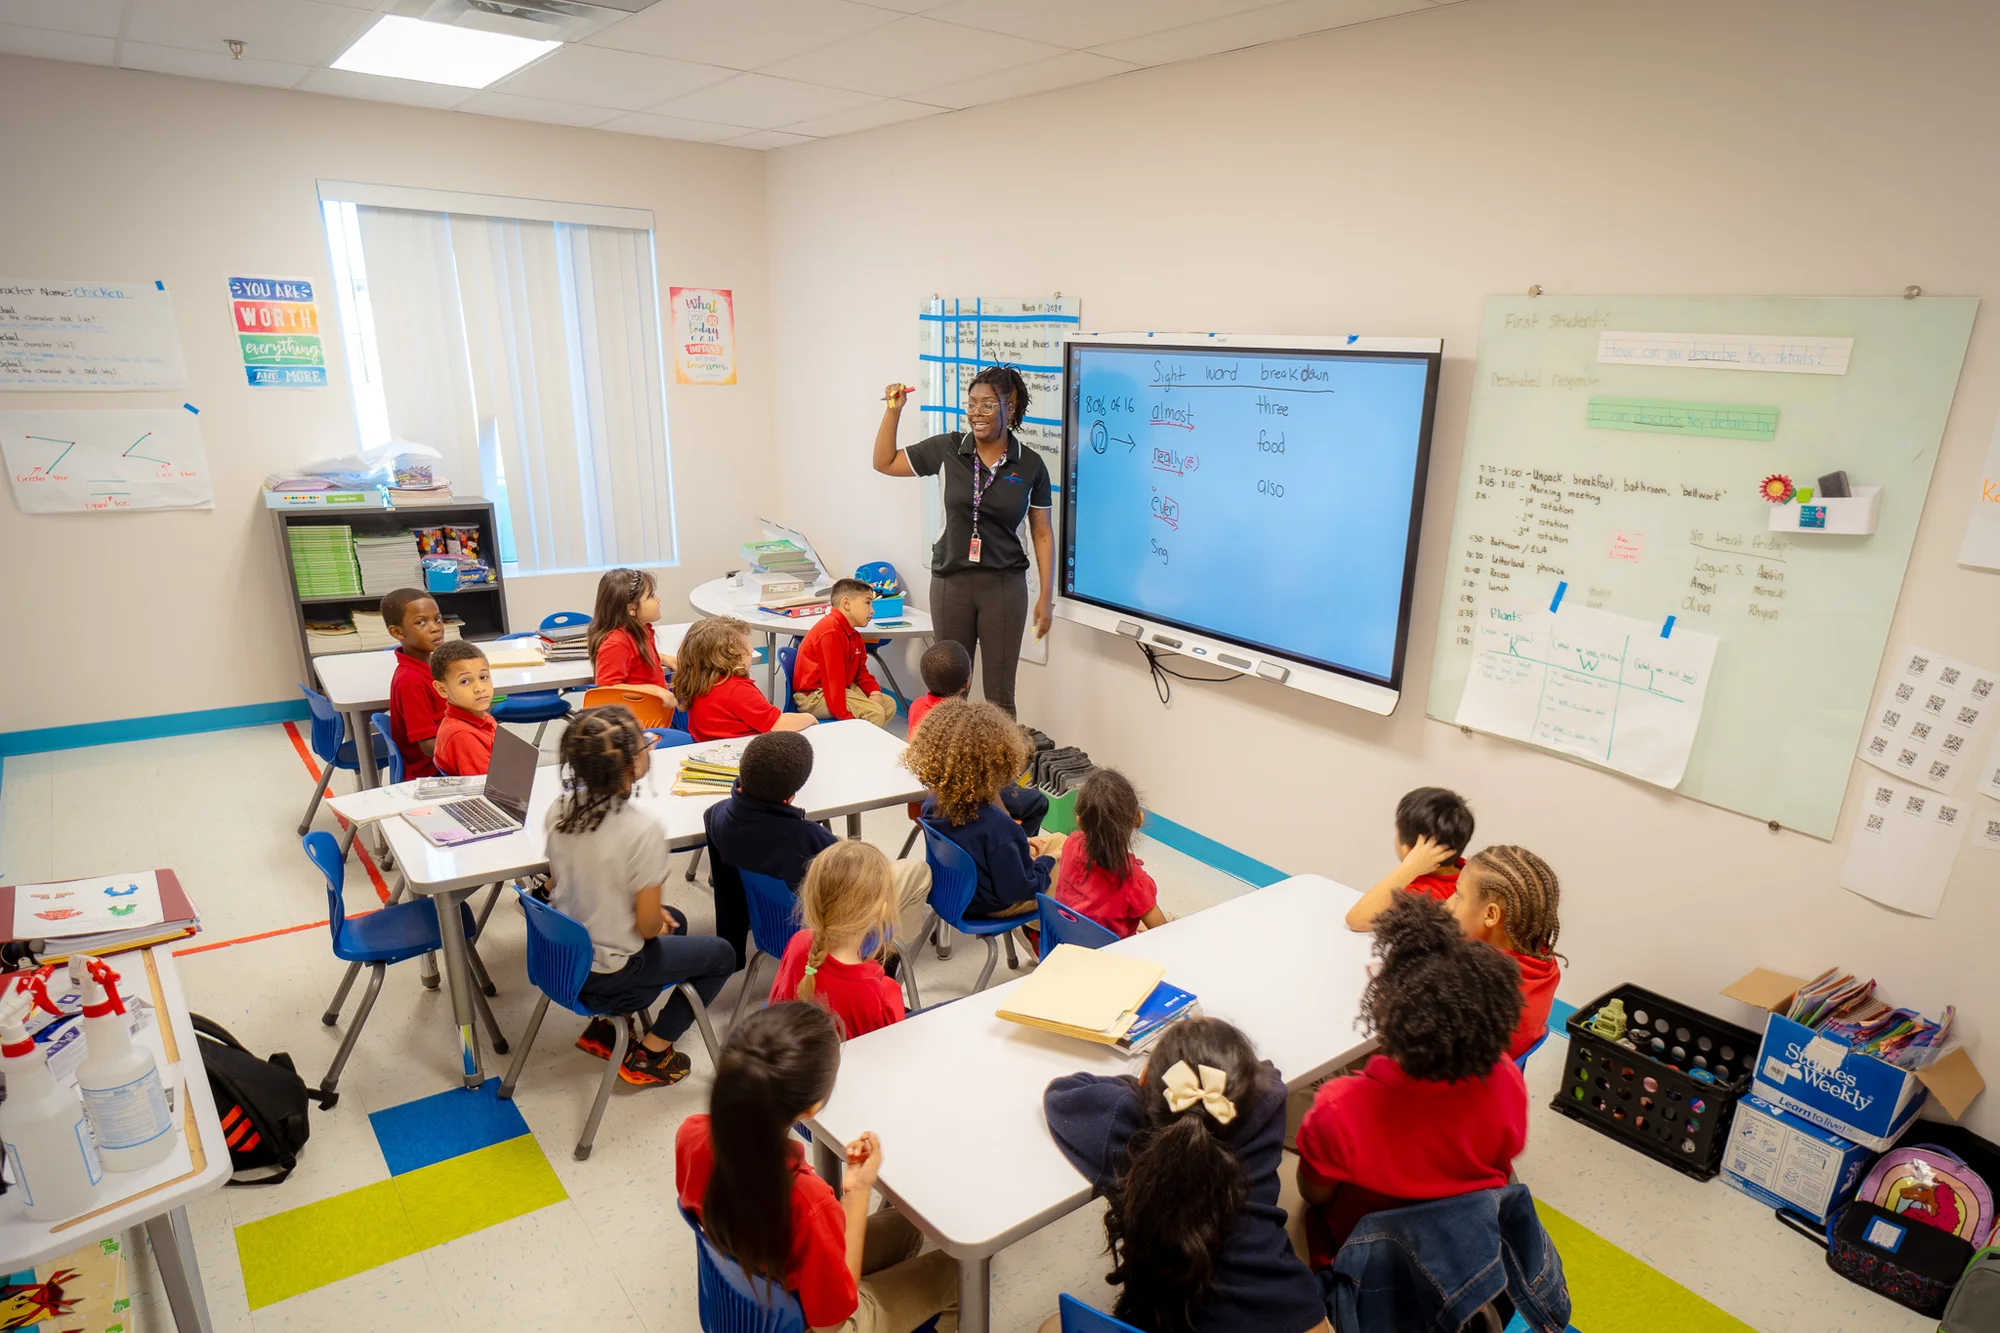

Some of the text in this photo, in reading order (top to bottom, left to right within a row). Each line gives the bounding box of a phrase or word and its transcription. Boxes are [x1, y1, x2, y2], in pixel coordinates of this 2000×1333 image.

[40, 287, 72, 297] Name:
[74, 286, 124, 298] Chicken
[242, 282, 301, 298] YOU ARE
[685, 295, 718, 313] What
[240, 307, 313, 328] WORTH
[1505, 312, 1539, 329] First
[689, 322, 719, 340] today
[246, 336, 319, 364] everything
[1604, 338, 1633, 358] How
[1642, 347, 1659, 358] can
[1667, 347, 1683, 363] you
[1688, 340, 1737, 360] describe
[256, 370, 320, 383] AND MORE
[1152, 360, 1186, 392] Sight
[1205, 363, 1238, 382] word
[1124, 396, 1135, 413] 16
[1151, 402, 1194, 423] almost
[1256, 395, 1289, 417] three
[1634, 406, 1682, 427] describe
[1257, 430, 1285, 455] food
[1258, 479, 1284, 498] also
[1530, 483, 1561, 503] Morning
[1567, 490, 1601, 505] meeting
[1540, 502, 1574, 514] rotation
[1538, 519, 1569, 530] rotation
[1490, 536, 1521, 550] Bathroom
[1536, 532, 1568, 544] rotation
[1715, 530, 1743, 546] treat
[1489, 567, 1510, 579] Recess
[1536, 563, 1565, 575] phonics
[1690, 576, 1716, 595] Angel
[1490, 607, 1523, 622] Plants
[1509, 636, 1519, 657] K
[1578, 654, 1599, 671] W
[1785, 1042, 1856, 1087] Stues
[1803, 1065, 1872, 1111] Weekly
[1778, 1096, 1811, 1118] Learn
[1812, 1111, 1823, 1123] to
[1824, 1116, 1846, 1134] live!
